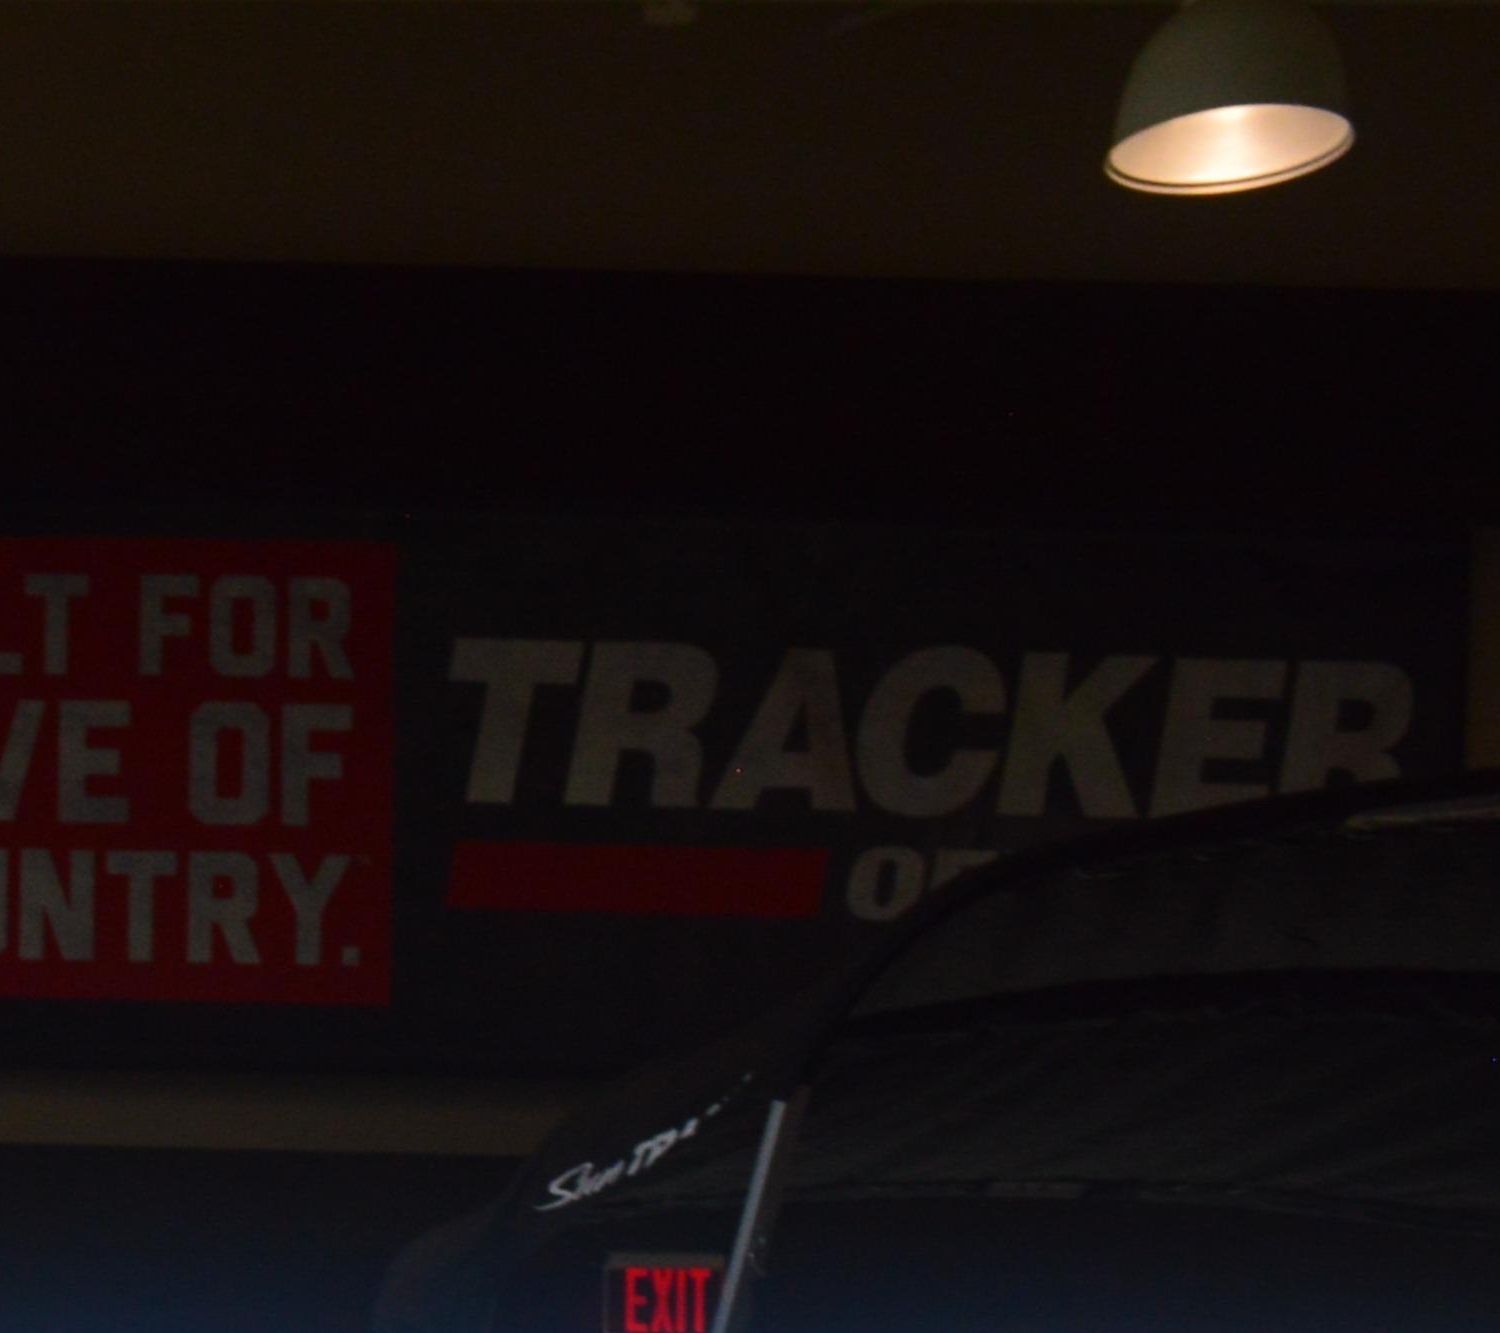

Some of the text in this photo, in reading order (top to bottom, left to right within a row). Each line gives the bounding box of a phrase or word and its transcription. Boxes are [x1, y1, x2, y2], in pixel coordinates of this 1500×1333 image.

[137, 573, 356, 681] FOR
[187, 700, 356, 828] OF
[447, 636, 1417, 820] TRACKER
